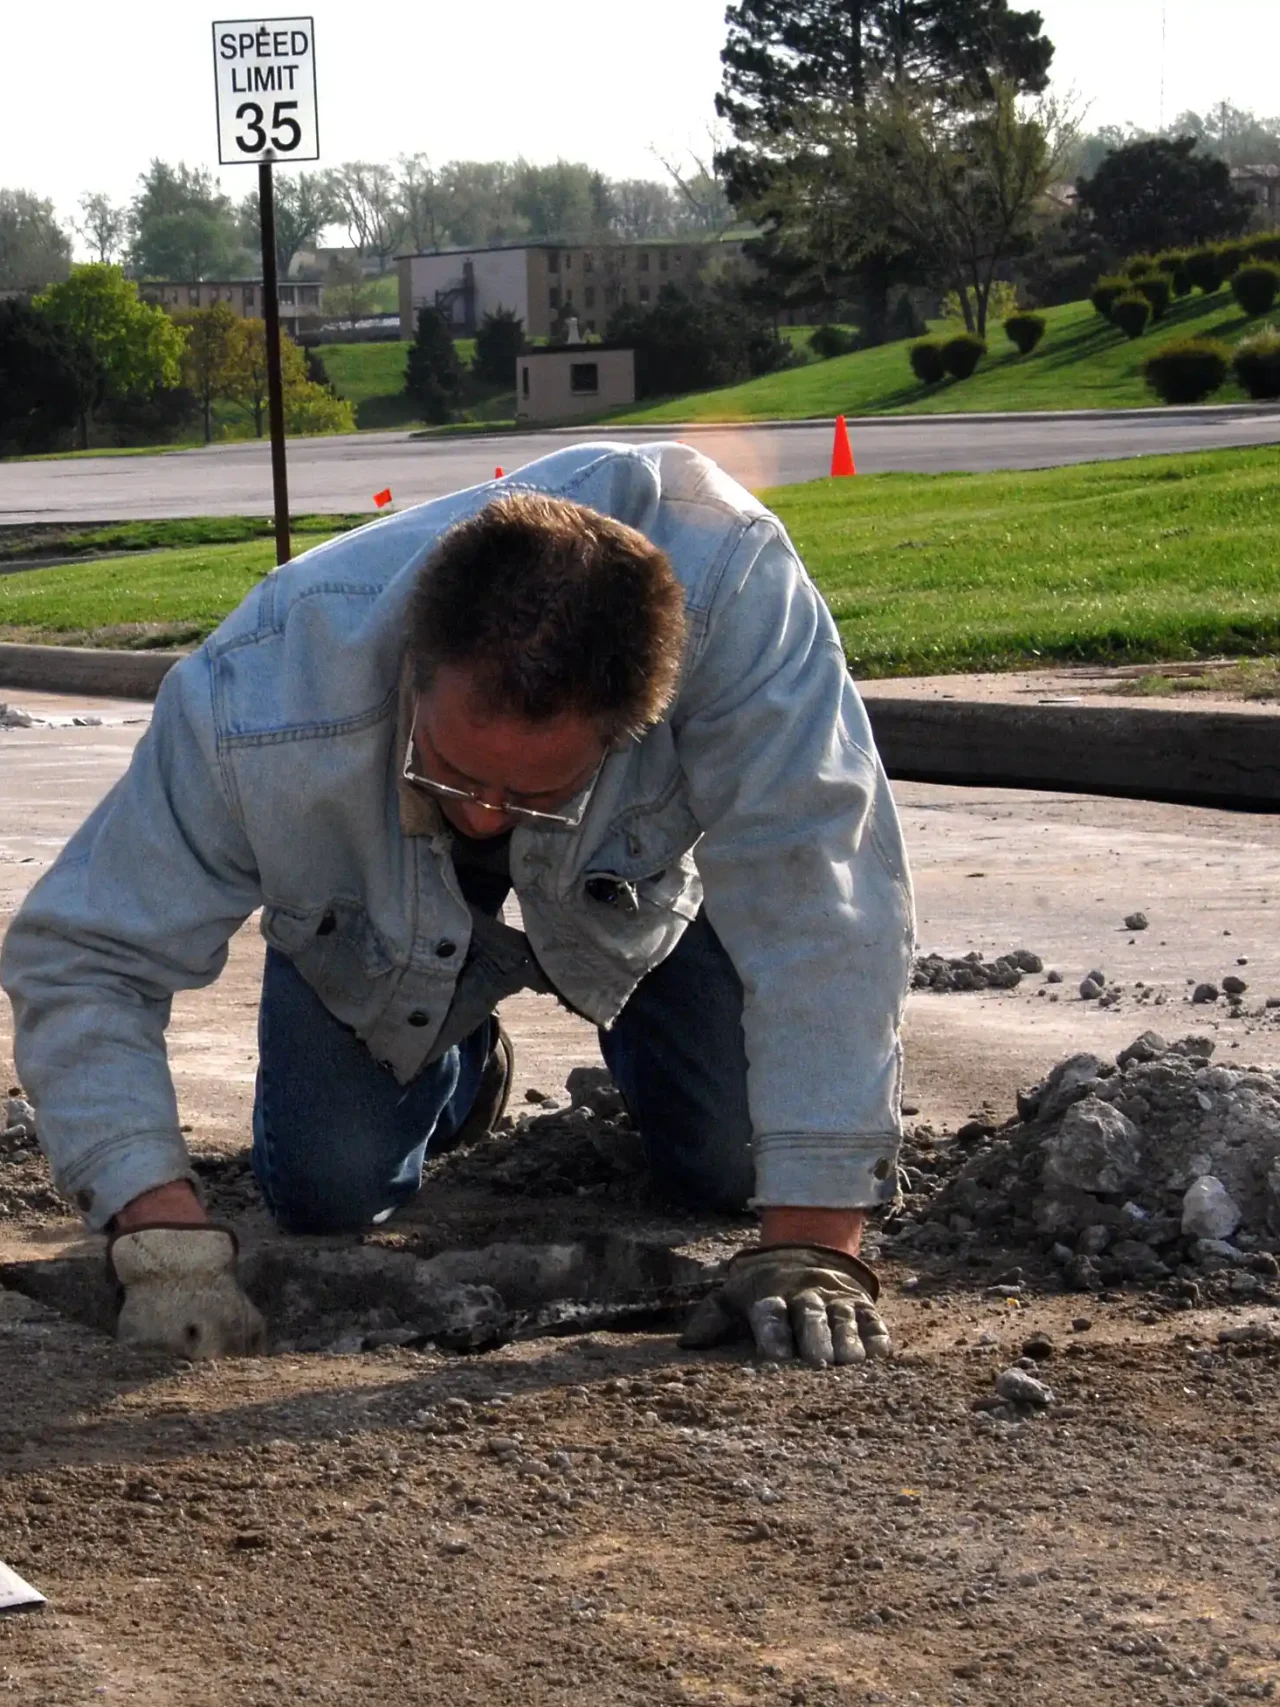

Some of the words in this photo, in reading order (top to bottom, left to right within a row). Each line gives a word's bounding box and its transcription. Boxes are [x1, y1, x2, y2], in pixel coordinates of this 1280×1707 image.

[220, 31, 308, 60] SPEED
[232, 65, 299, 93] LIMIT
[235, 100, 302, 154] 35
